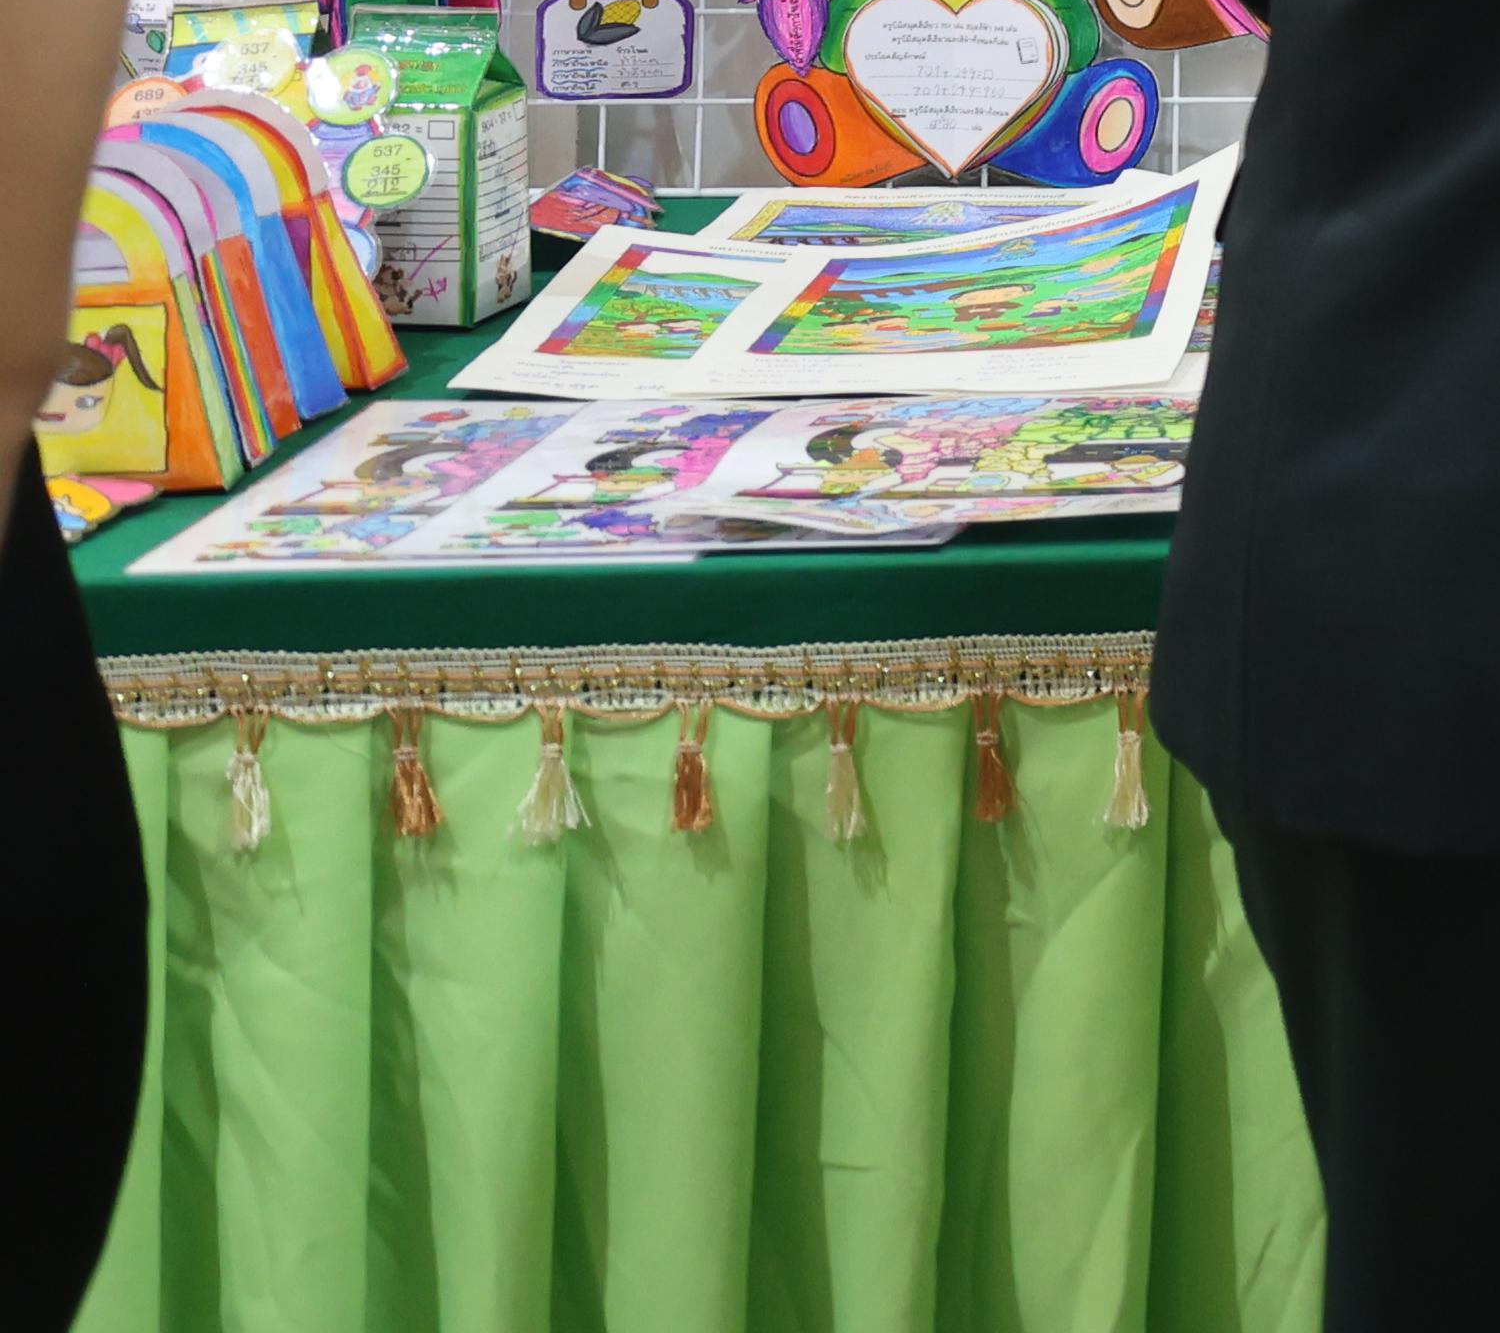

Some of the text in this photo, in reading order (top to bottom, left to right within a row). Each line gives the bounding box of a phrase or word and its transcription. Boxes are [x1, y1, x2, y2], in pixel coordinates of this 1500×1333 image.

[134, 88, 165, 102] 689
[374, 145, 403, 158] 537
[371, 164, 400, 177] 345
